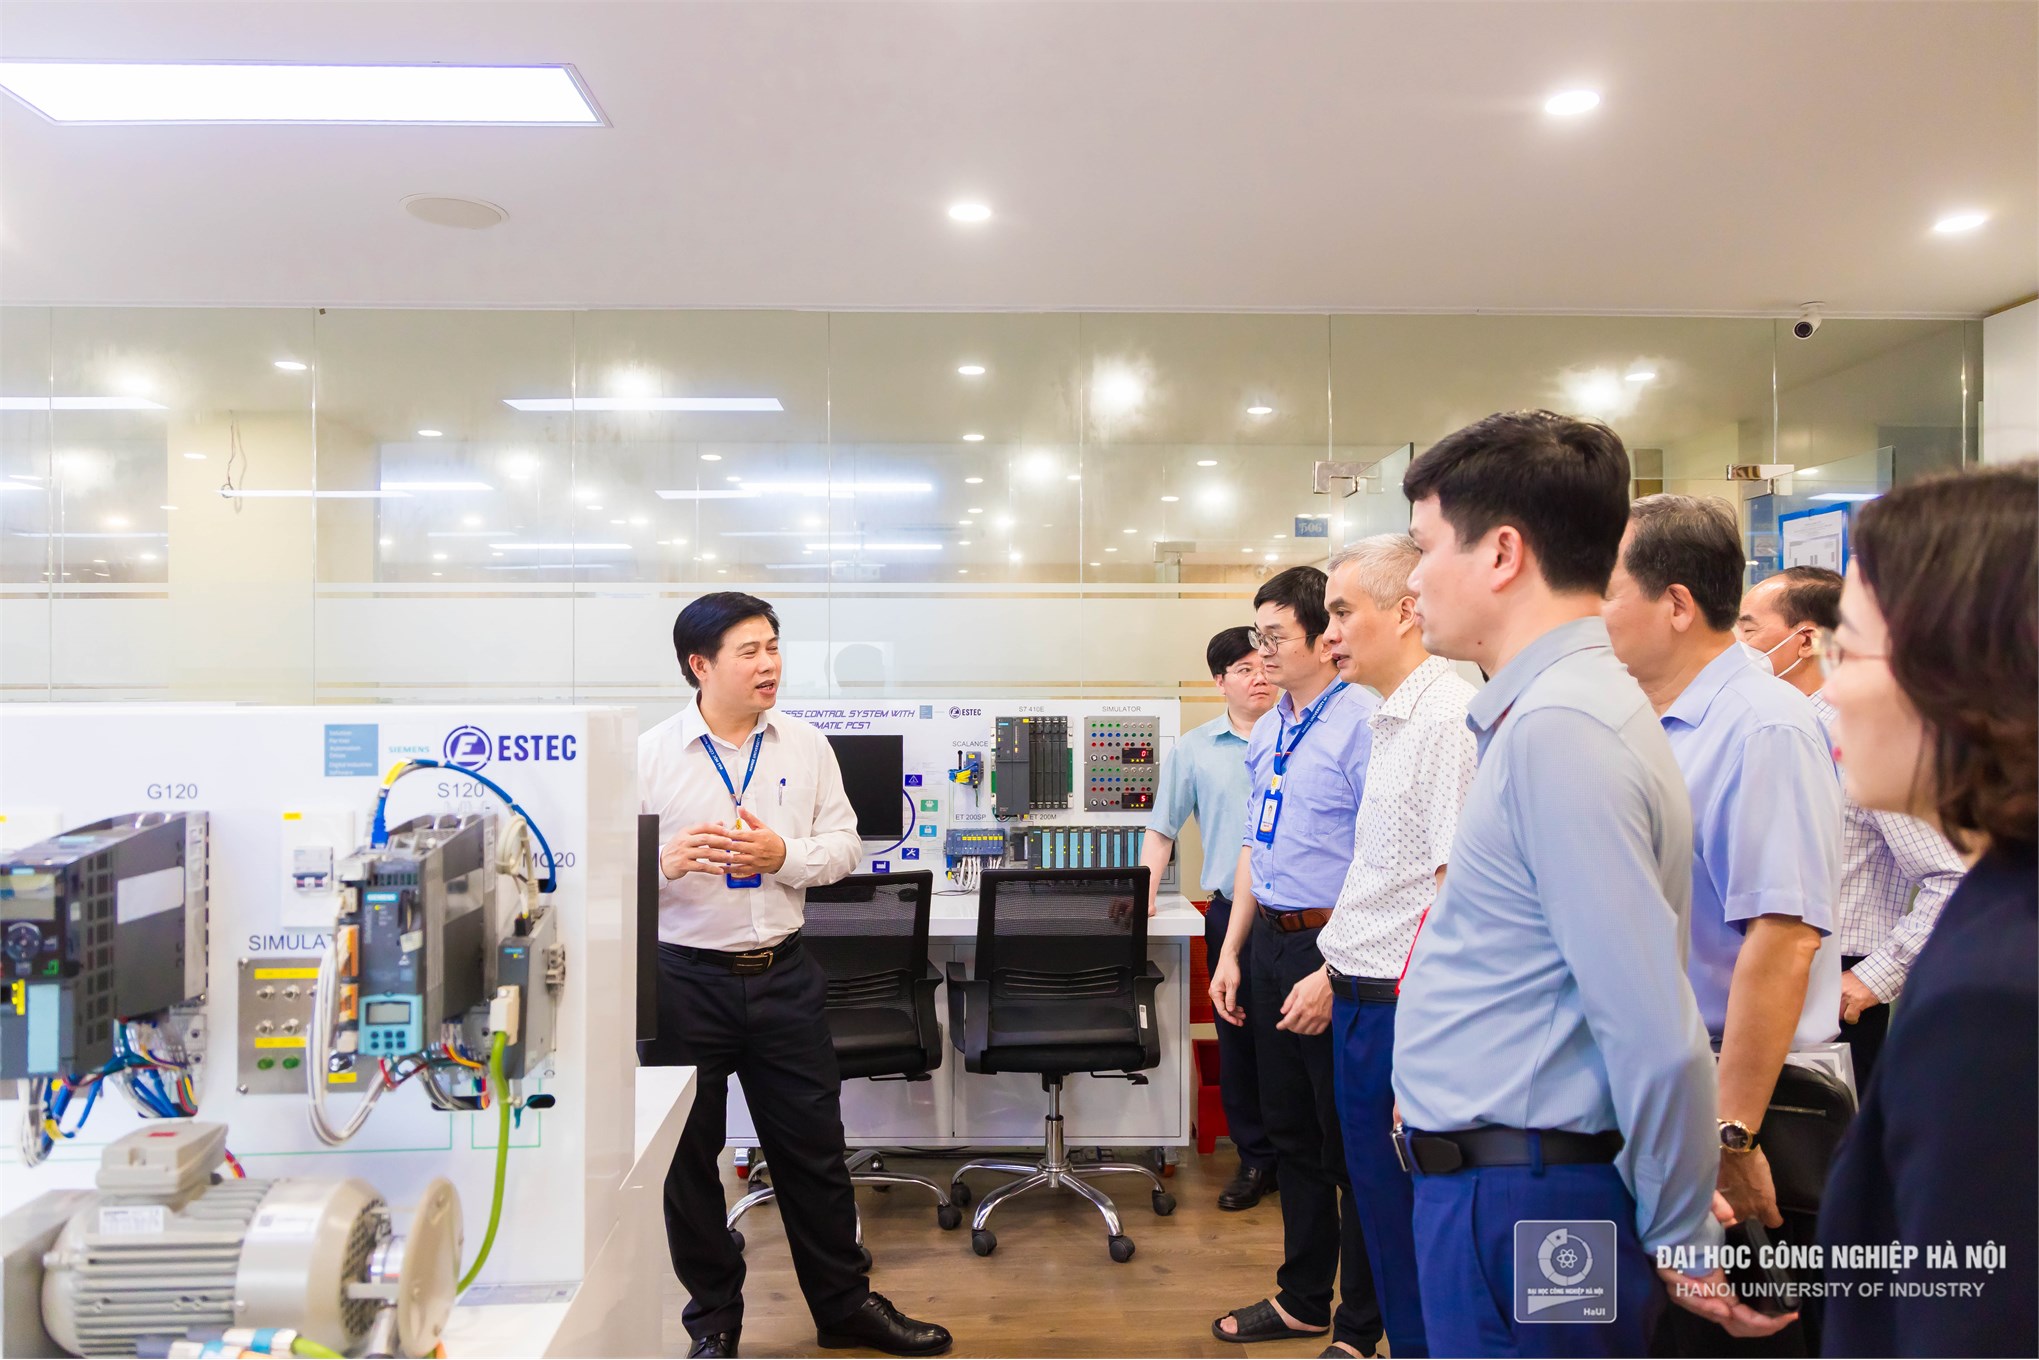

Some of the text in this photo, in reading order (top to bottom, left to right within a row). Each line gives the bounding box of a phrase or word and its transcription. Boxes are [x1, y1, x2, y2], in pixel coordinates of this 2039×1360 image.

[804, 710, 846, 718] CONTROL
[848, 710, 889, 718] SYSTEM
[891, 710, 915, 718] WITH
[962, 708, 982, 716] ESTEC
[845, 721, 870, 730] PCS7
[498, 735, 576, 761] ESTEC
[147, 783, 198, 800] G120
[437, 782, 484, 798] S120
[248, 933, 333, 951] SIMULA
